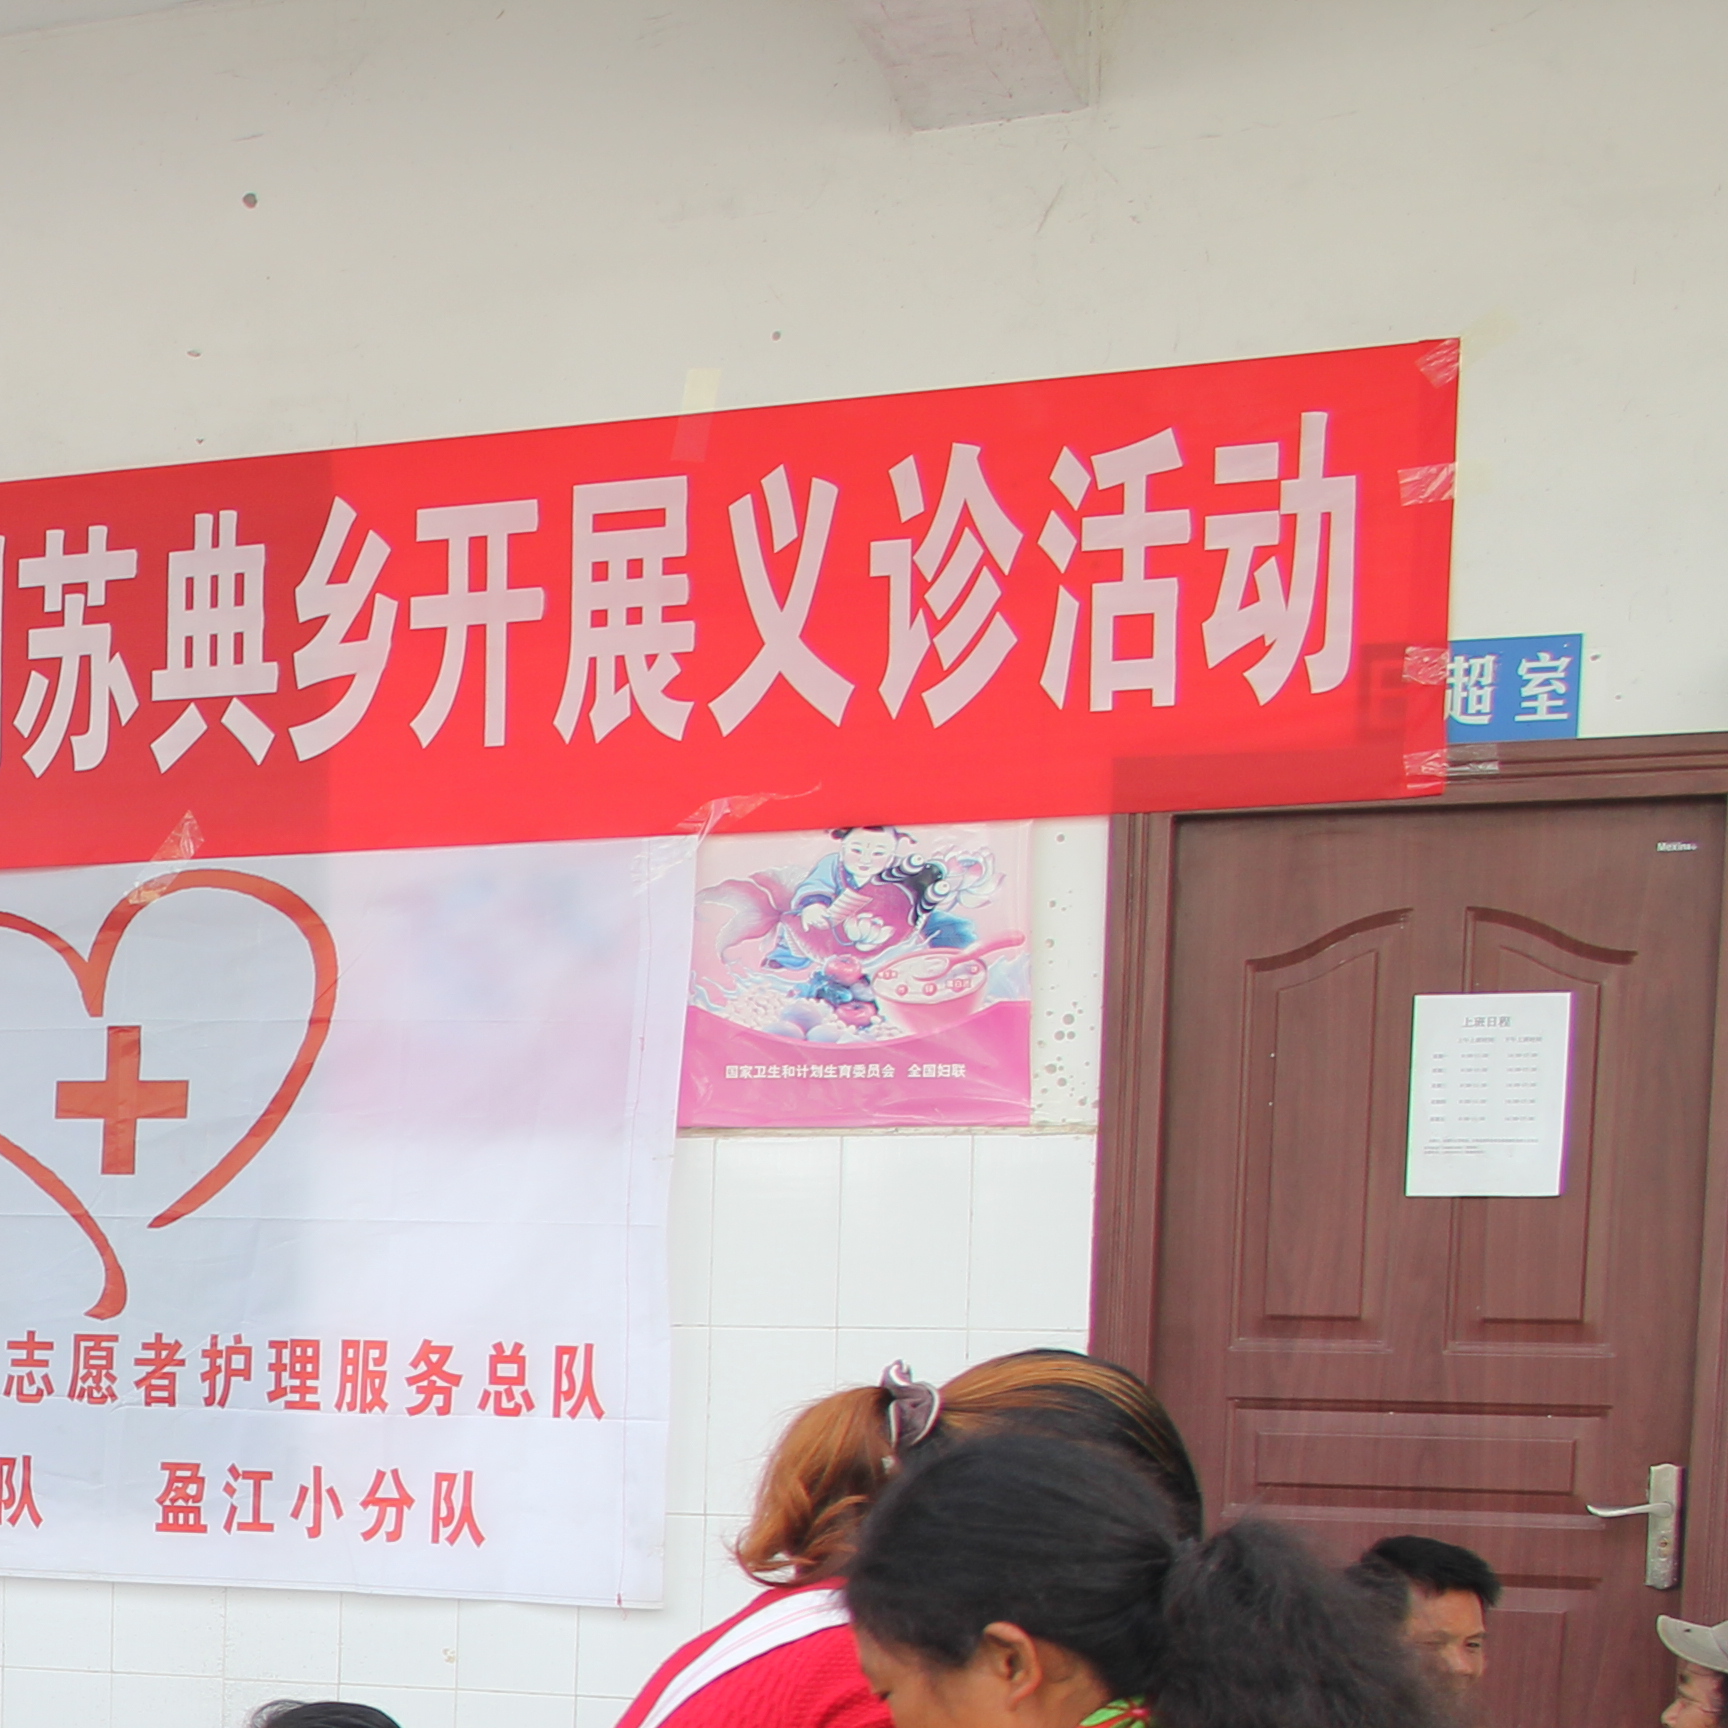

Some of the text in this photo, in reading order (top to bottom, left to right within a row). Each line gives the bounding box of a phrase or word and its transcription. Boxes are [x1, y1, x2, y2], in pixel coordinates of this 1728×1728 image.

[724, 1063, 967, 1079] 国家卫生和计划生育委员会 全国妇联
[154, 1462, 486, 1549] 盈江小分队
